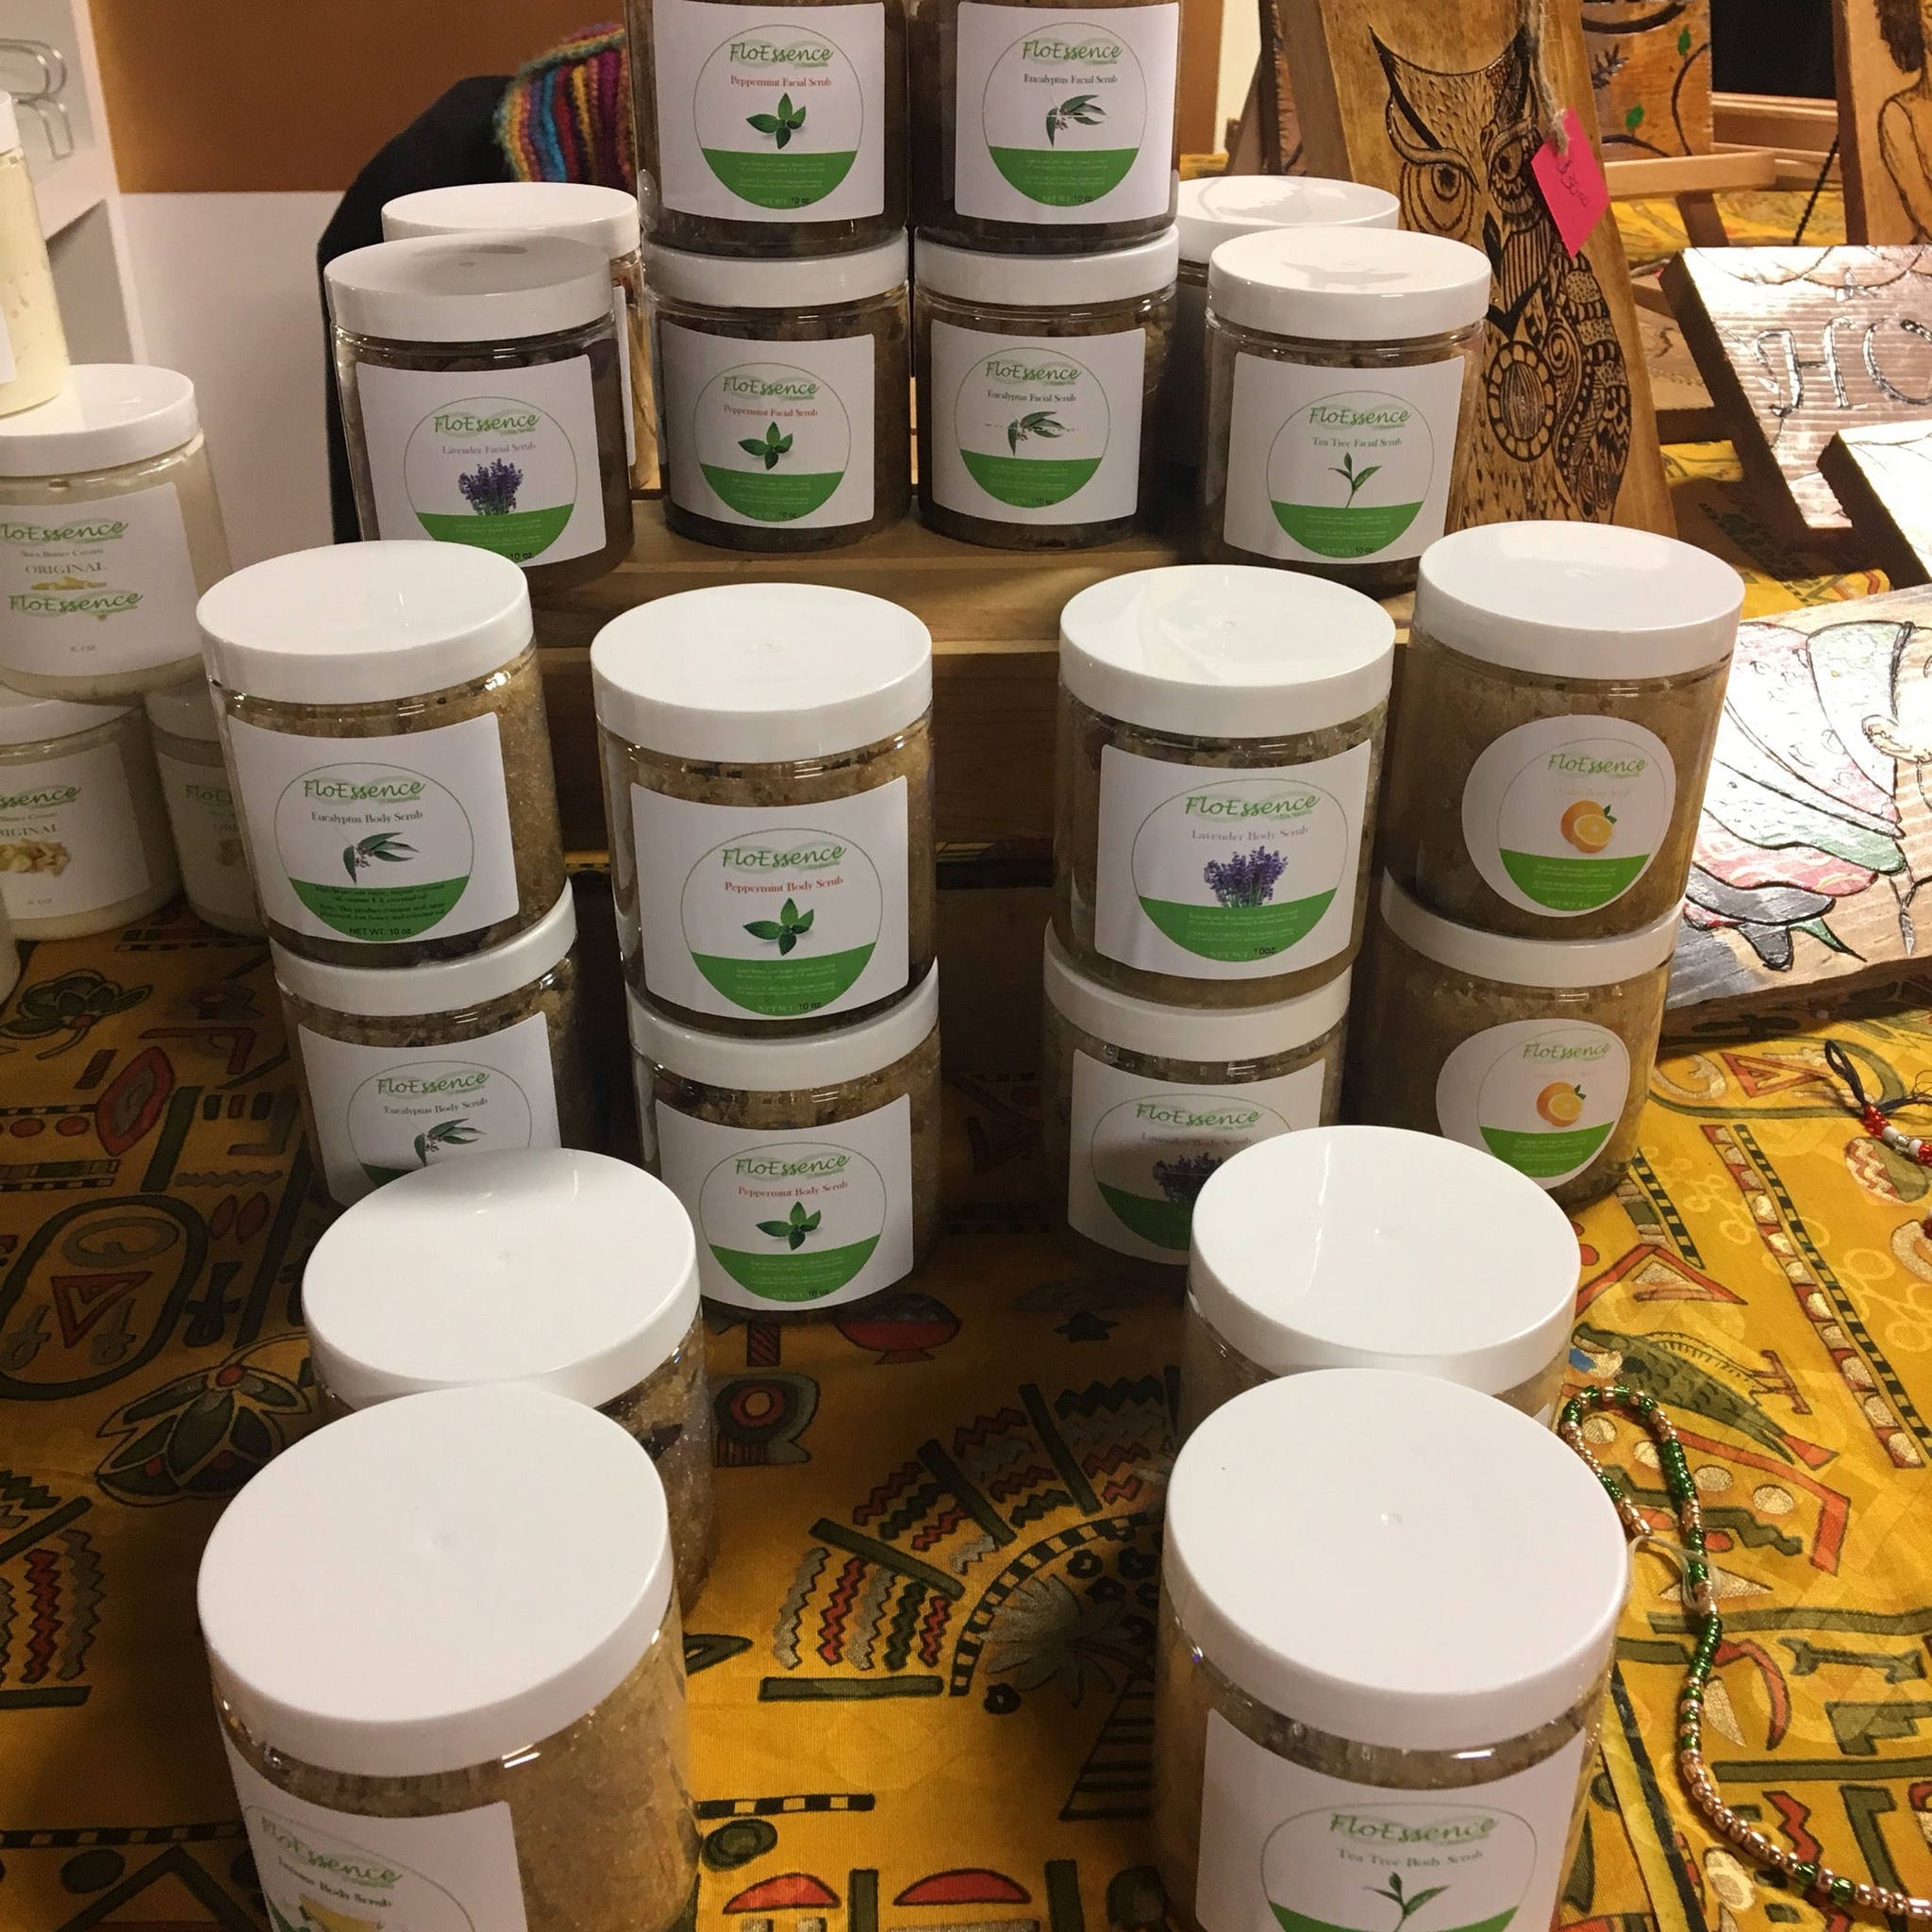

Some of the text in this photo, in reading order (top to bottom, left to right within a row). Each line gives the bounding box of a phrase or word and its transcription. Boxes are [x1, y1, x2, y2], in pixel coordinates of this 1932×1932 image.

[729, 42, 834, 63] FloEssence
[1022, 40, 1124, 60] FloEssence
[730, 75, 832, 87] Peppermint Facial Scrub
[1024, 74, 1118, 86] Eucalyptus Facial Scrub
[985, 360, 1082, 381] FloEssence
[723, 376, 820, 395] FloEssence
[988, 390, 1077, 402] Eucalyptus Facial Scrub
[724, 404, 819, 417] Peppermint Facial Scrub
[1308, 407, 1412, 425] FloEssence
[433, 412, 541, 433] FloEssence
[442, 441, 536, 455] Lavender Facial Scrub
[1312, 437, 1403, 447] Tea Tree Facial Scrub
[0, 521, 128, 541] loEssence
[25, 561, 107, 574] ORIGINAL
[8, 592, 143, 613] FloEssence
[1547, 753, 1646, 774] FloEssence
[303, 779, 425, 800] FloEssence
[1185, 794, 1321, 817] FloEssence
[311, 809, 424, 824] Eucalyptus Body Scrub
[1191, 825, 1308, 841] Lavender Body Scrub
[722, 844, 847, 868] FloEssence
[724, 876, 843, 894] Peppermint Body Scrub
[349, 927, 368, 936] NET
[389, 927, 399, 936] 10
[1523, 1041, 1612, 1059] FloEssence
[376, 1071, 490, 1095] FloEssence
[384, 1097, 488, 1116] Eucalyptus Body Scrub
[1135, 1103, 1263, 1127] FloEssence
[735, 1154, 851, 1176] FloEssence
[738, 1180, 848, 1198] Peppermint Body Scrub
[1330, 1811, 1498, 1843] FloEssence
[261, 1816, 403, 1883] FloEssence
[1336, 1847, 1484, 1868] Tea Tree Body Scrub
